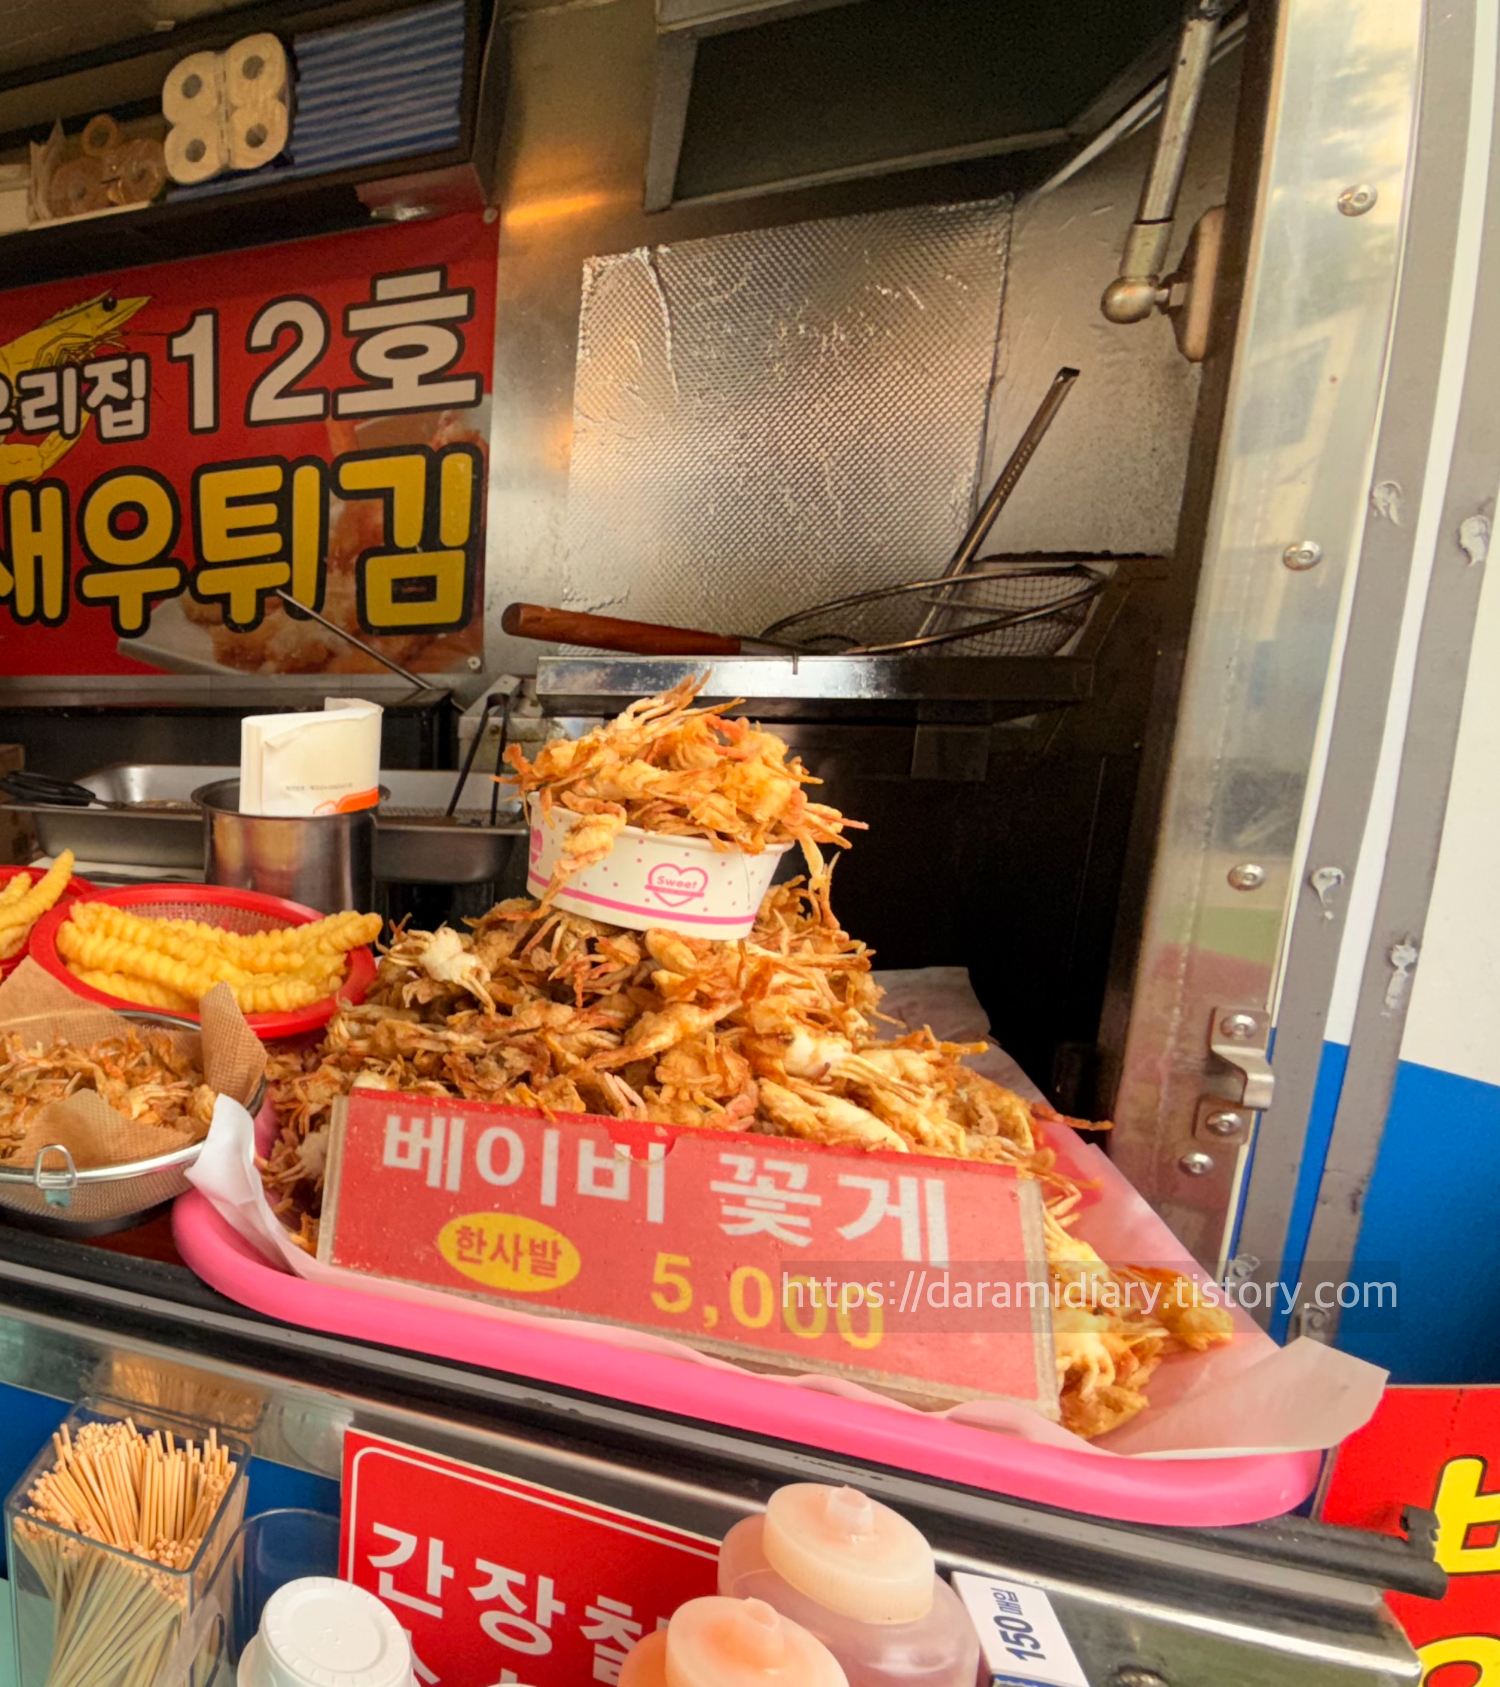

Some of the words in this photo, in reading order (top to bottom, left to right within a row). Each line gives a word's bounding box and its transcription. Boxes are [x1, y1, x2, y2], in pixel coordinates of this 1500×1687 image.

[169, 267, 482, 432] 12호
[381, 1114, 666, 1224] 베이비
[710, 1153, 950, 1270] 꽃게
[453, 1223, 563, 1280] 한사발
[651, 1252, 883, 1350] 5,000
